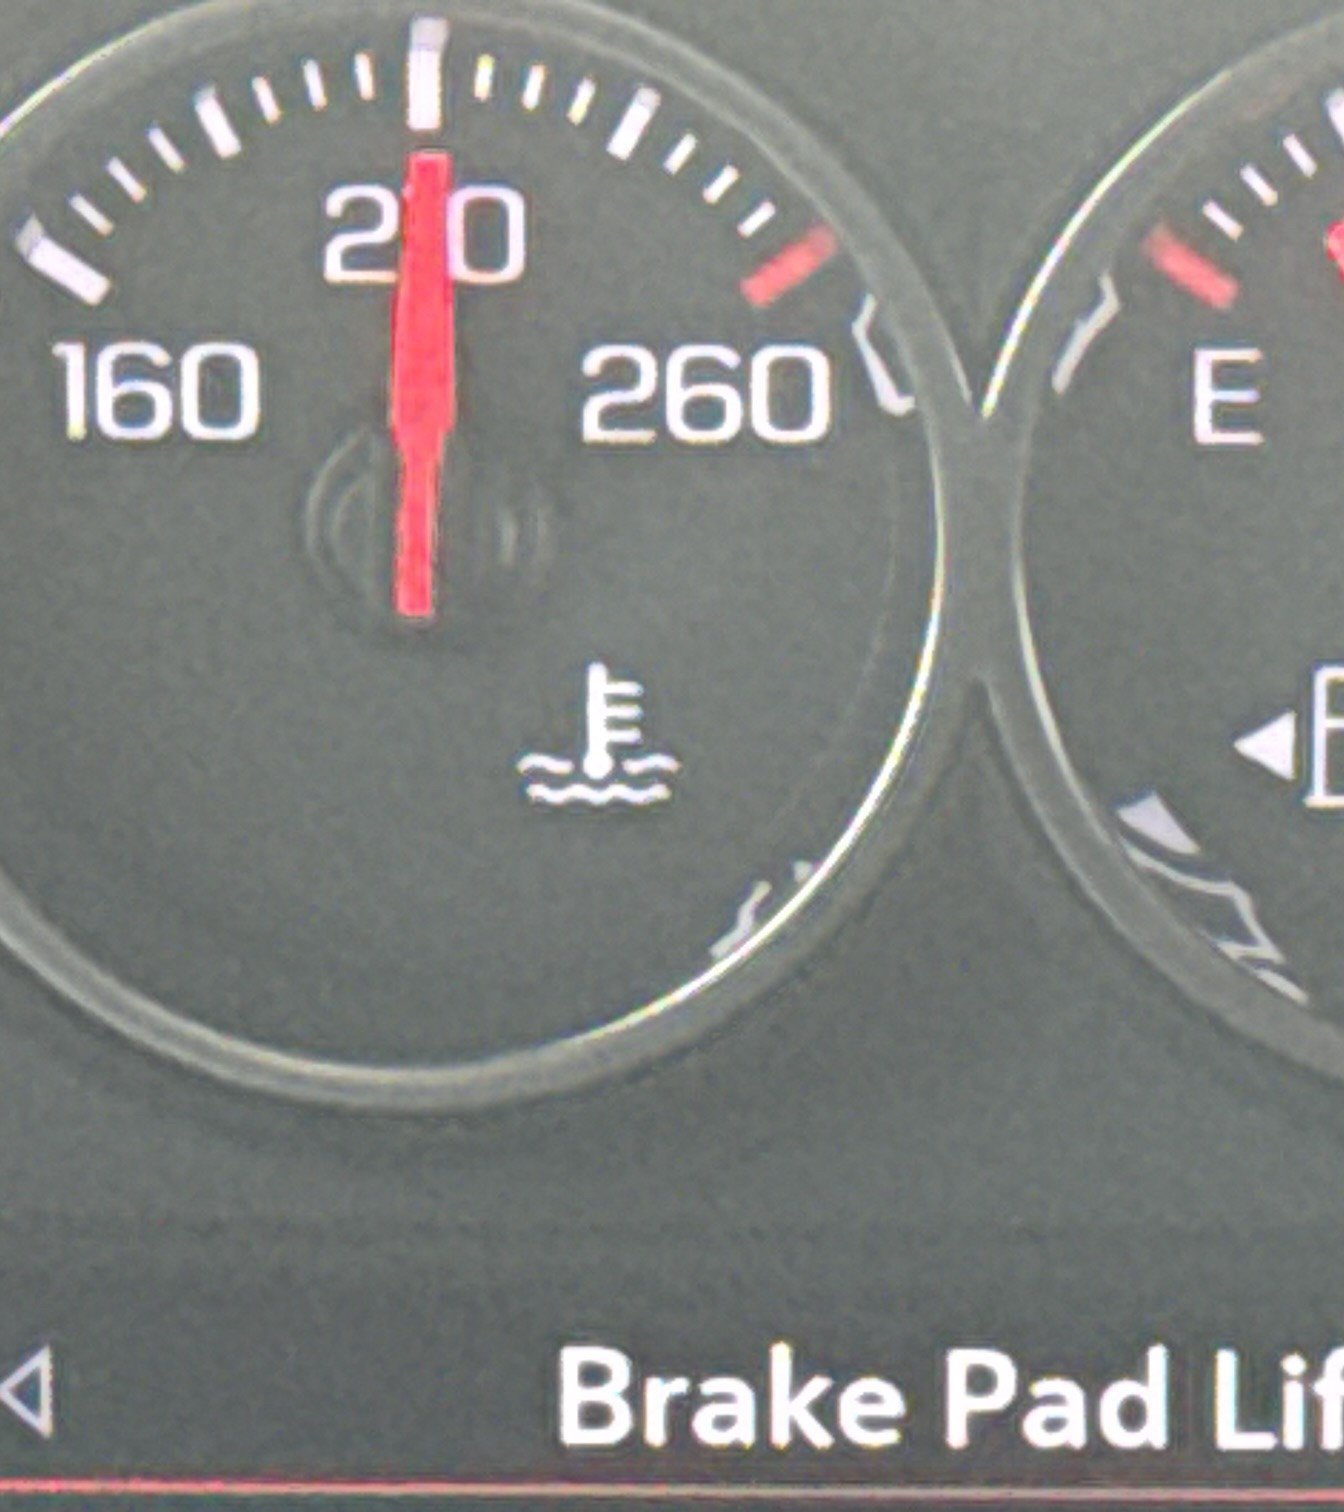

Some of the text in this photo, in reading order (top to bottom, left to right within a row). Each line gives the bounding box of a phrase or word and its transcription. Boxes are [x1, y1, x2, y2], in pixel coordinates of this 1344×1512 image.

[322, 183, 527, 285] 20
[51, 340, 262, 442] 160
[581, 343, 832, 445] 260
[1192, 347, 1264, 446] E
[558, 1339, 908, 1451] Brake
[944, 1342, 1170, 1451] Pad
